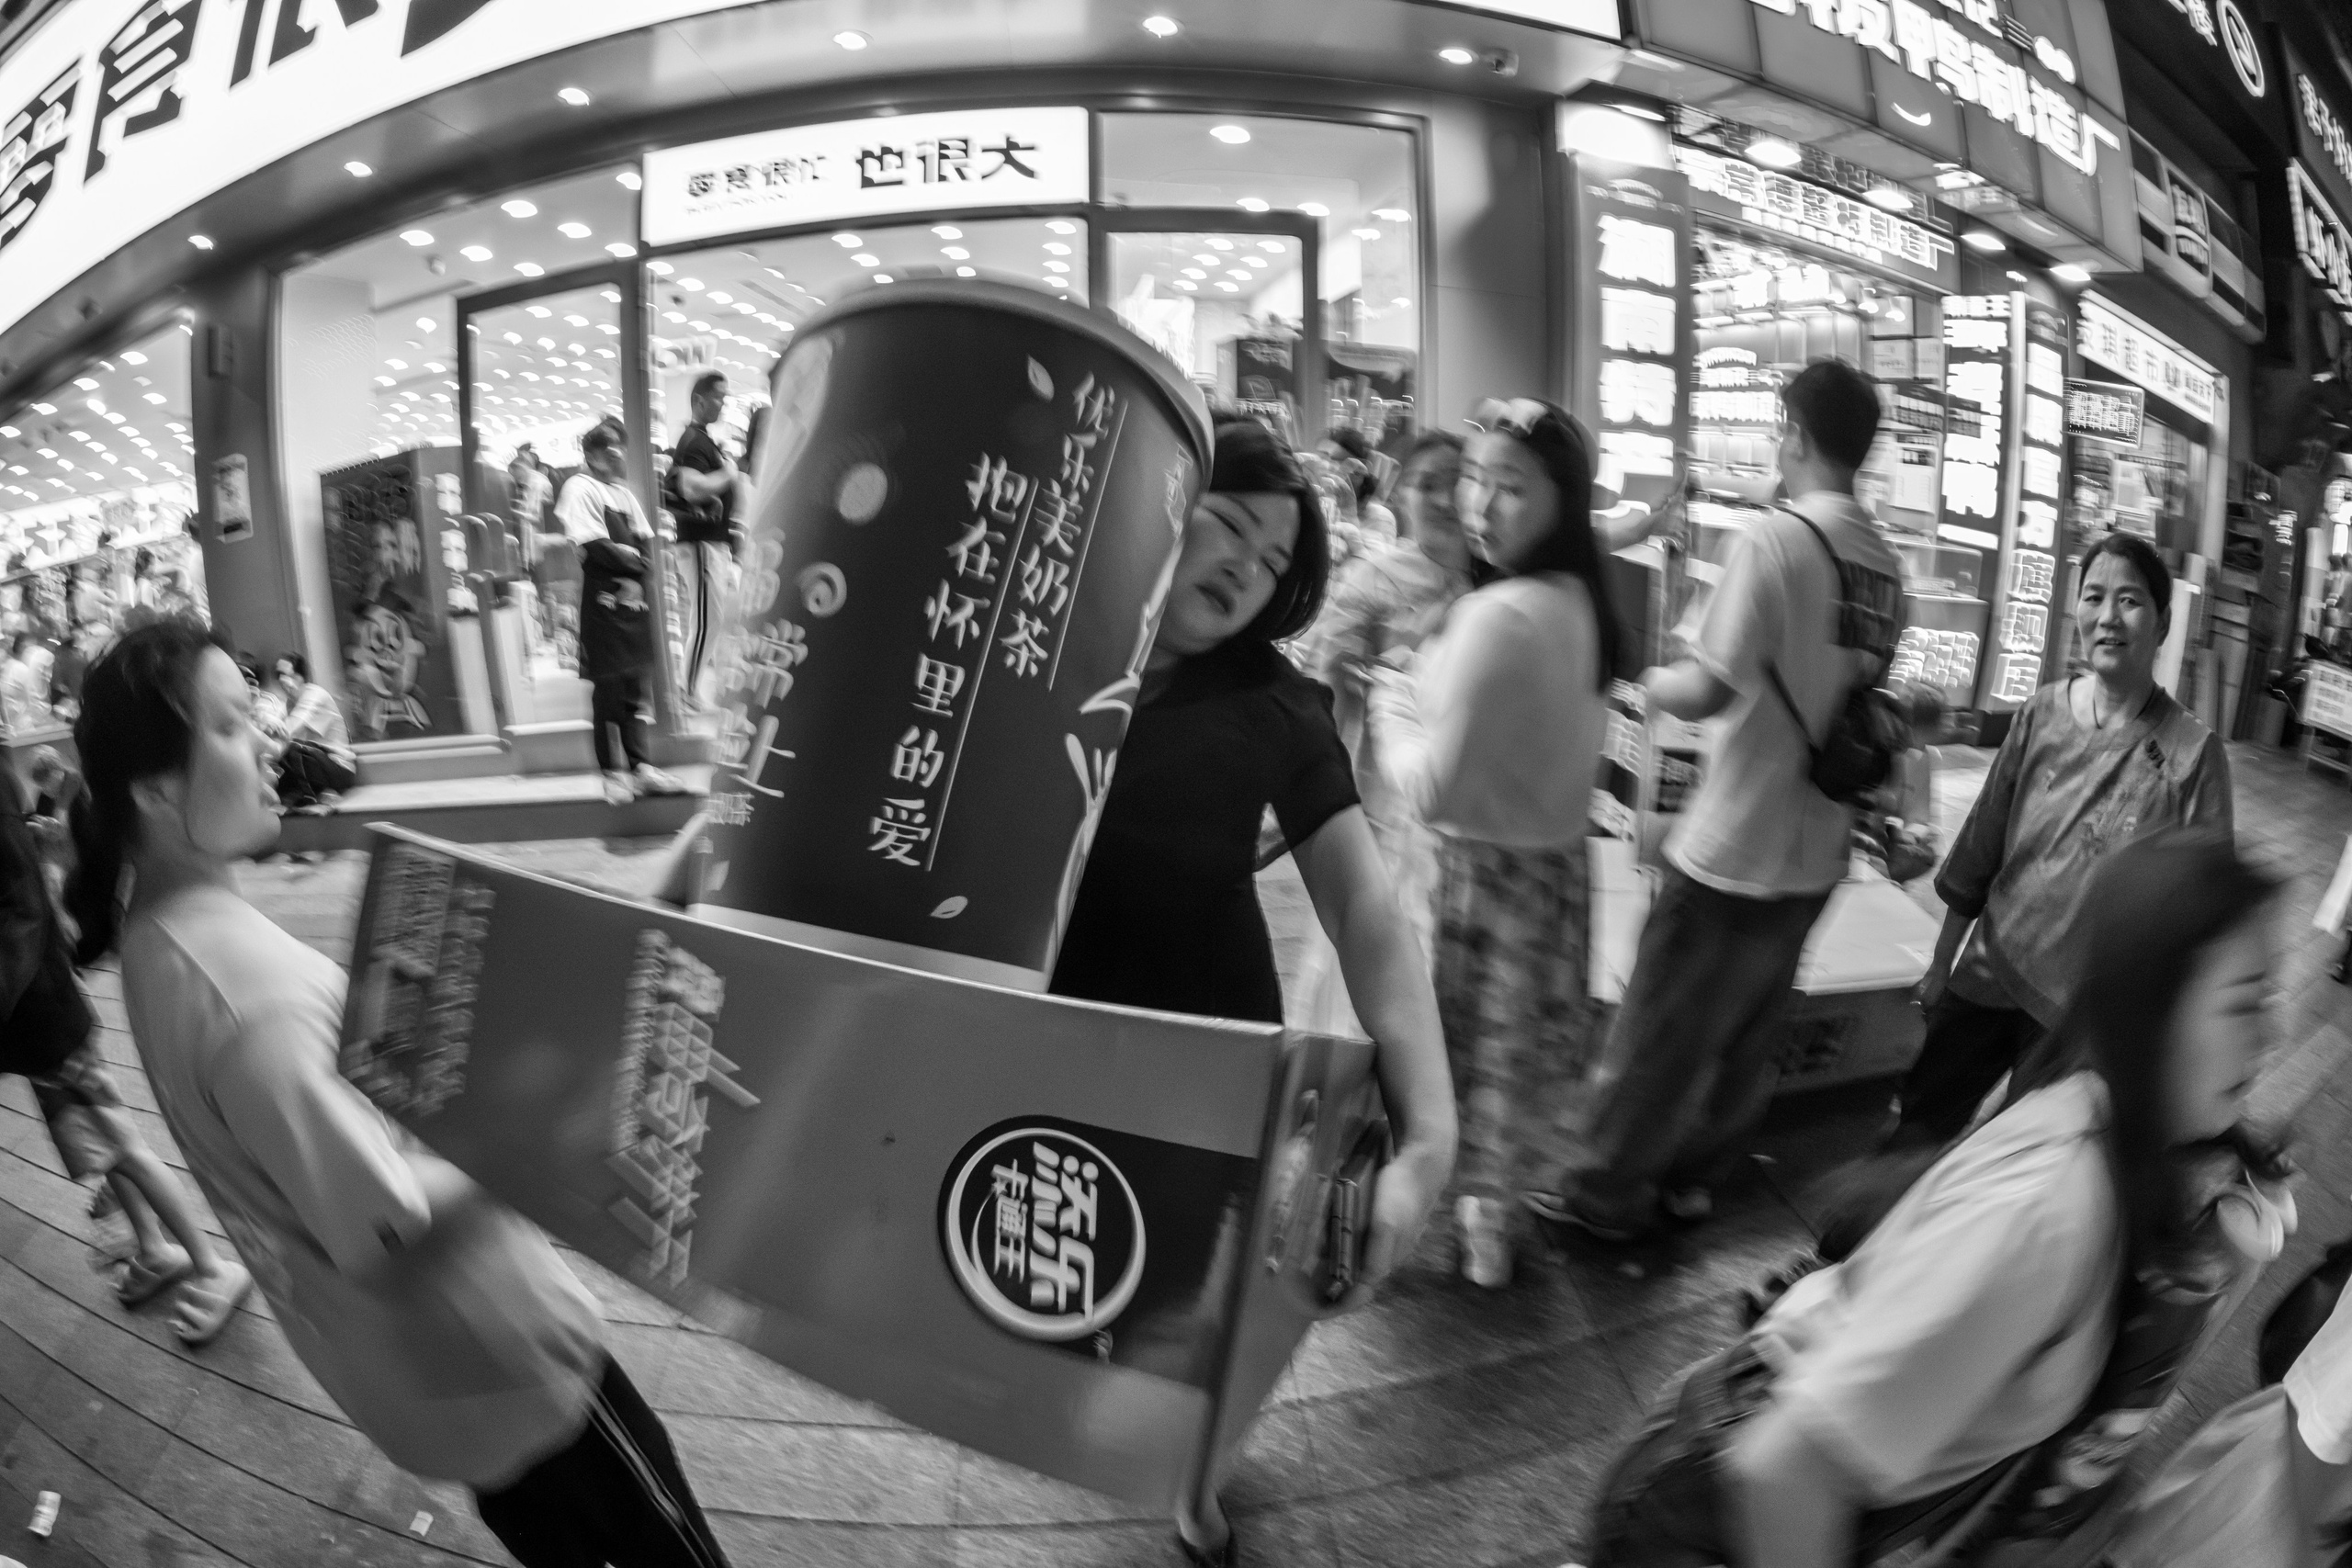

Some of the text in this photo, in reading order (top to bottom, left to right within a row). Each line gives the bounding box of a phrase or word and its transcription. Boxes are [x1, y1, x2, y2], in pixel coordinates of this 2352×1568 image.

[855, 134, 1036, 188] 也很大
[999, 370, 1117, 678] 优乐美奶茶
[866, 451, 1028, 867] 抱在怀里的爱
[990, 1158, 1029, 1283] 卡通王
[1030, 1141, 1099, 1319] 添乐
